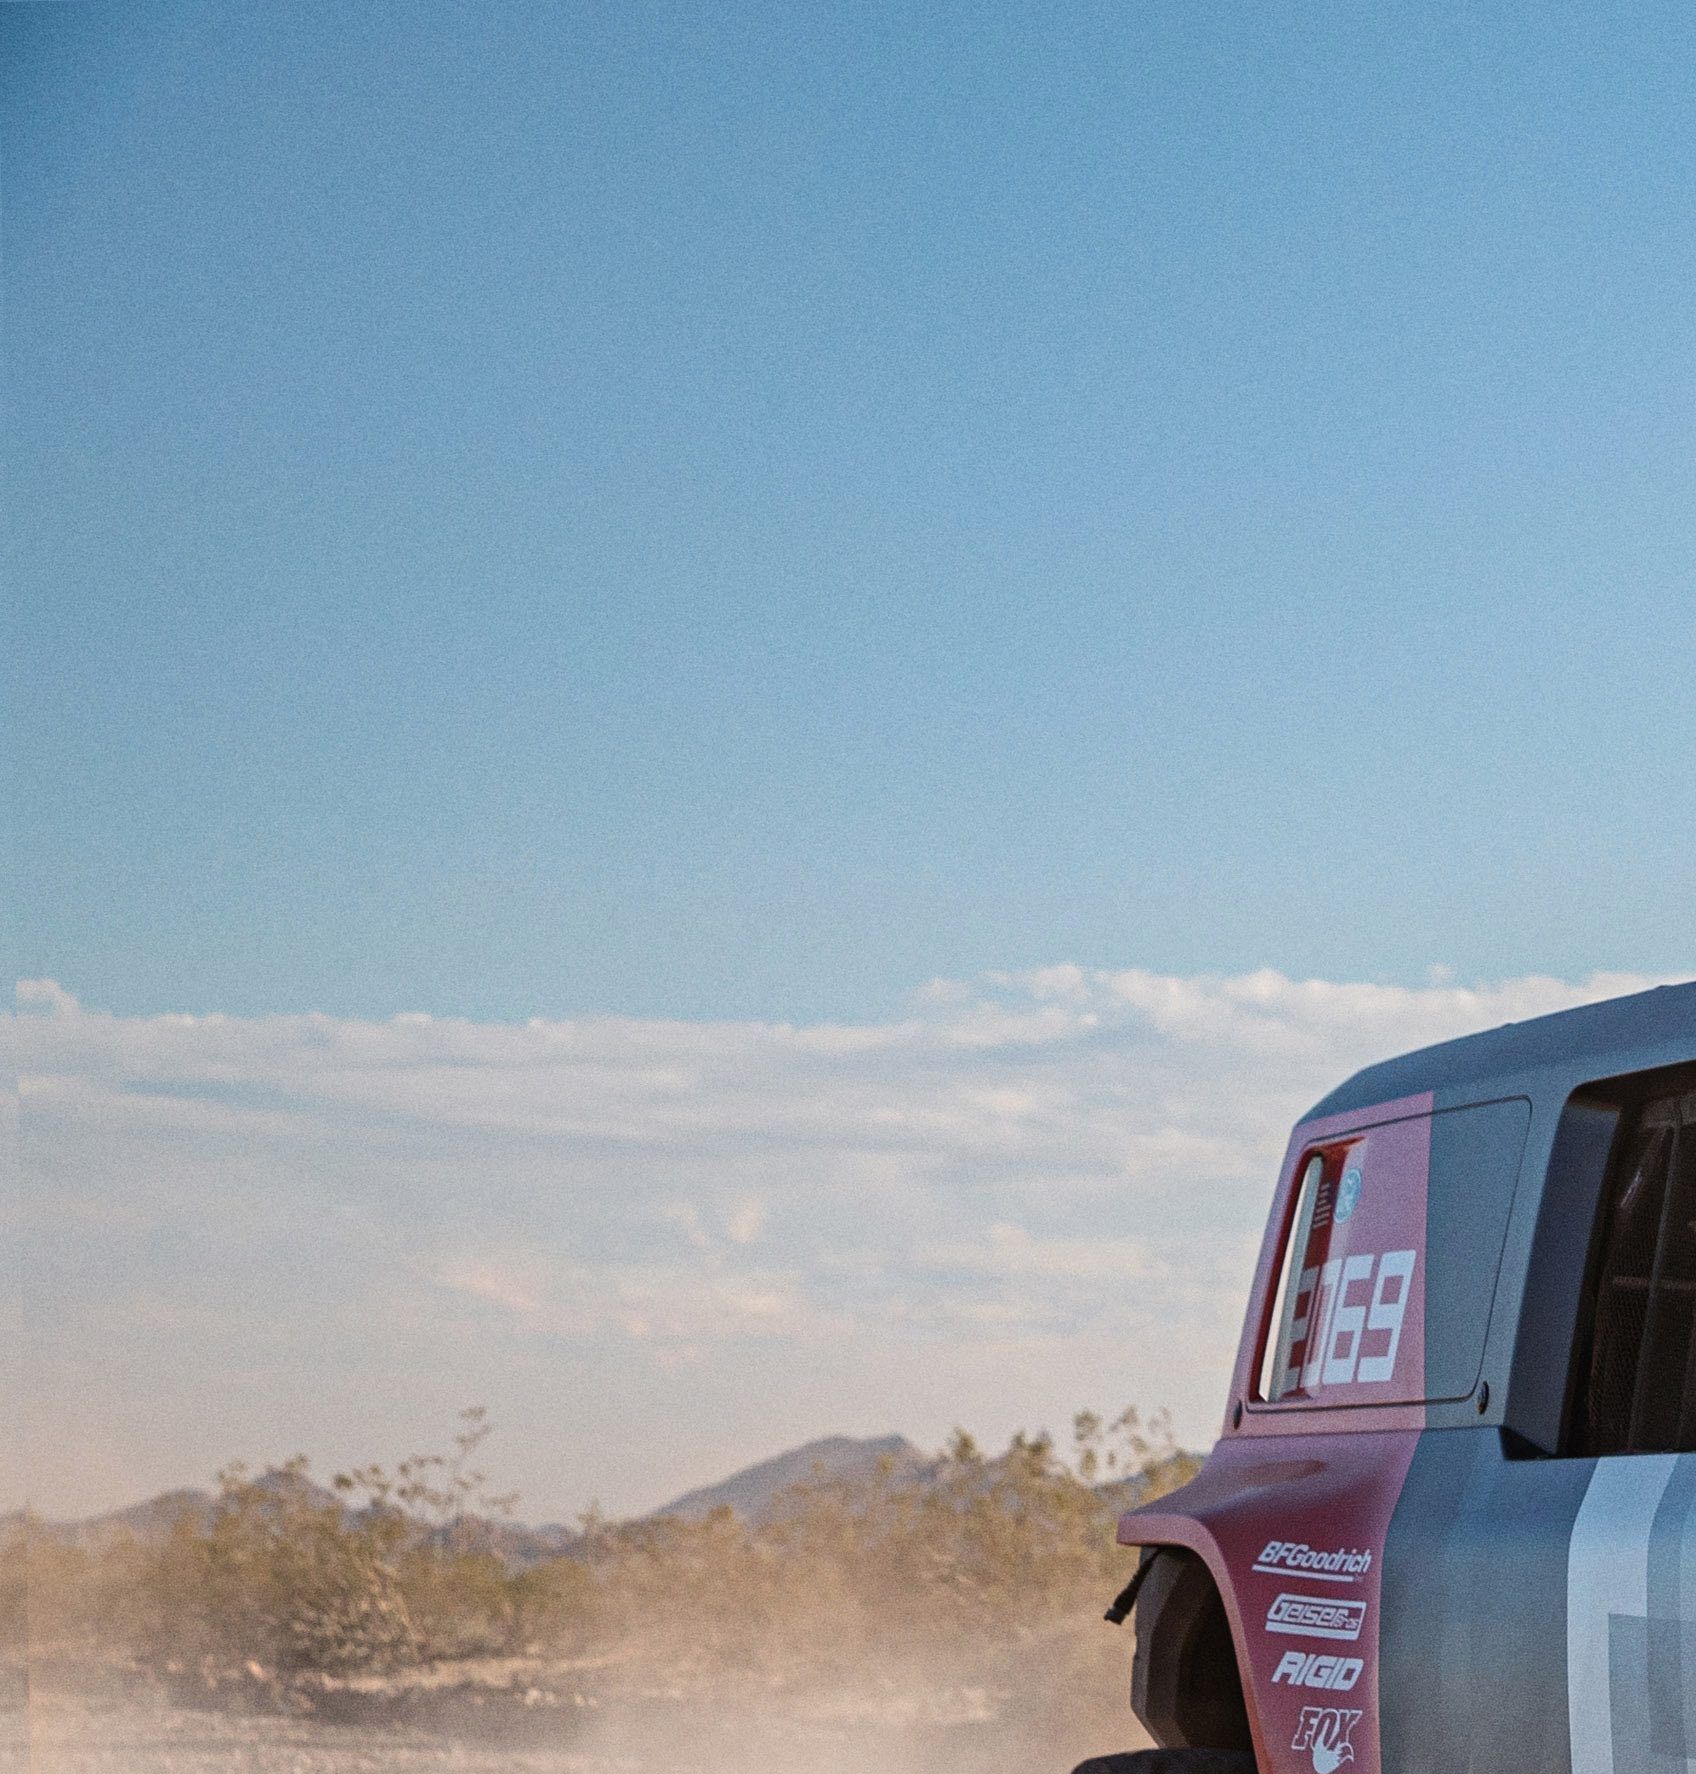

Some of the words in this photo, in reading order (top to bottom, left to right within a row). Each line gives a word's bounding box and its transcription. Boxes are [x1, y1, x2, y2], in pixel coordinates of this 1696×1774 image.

[1257, 1540, 1372, 1574] BFGoodrich
[1271, 1651, 1364, 1691] RIGID
[1291, 1706, 1363, 1752] FOX
